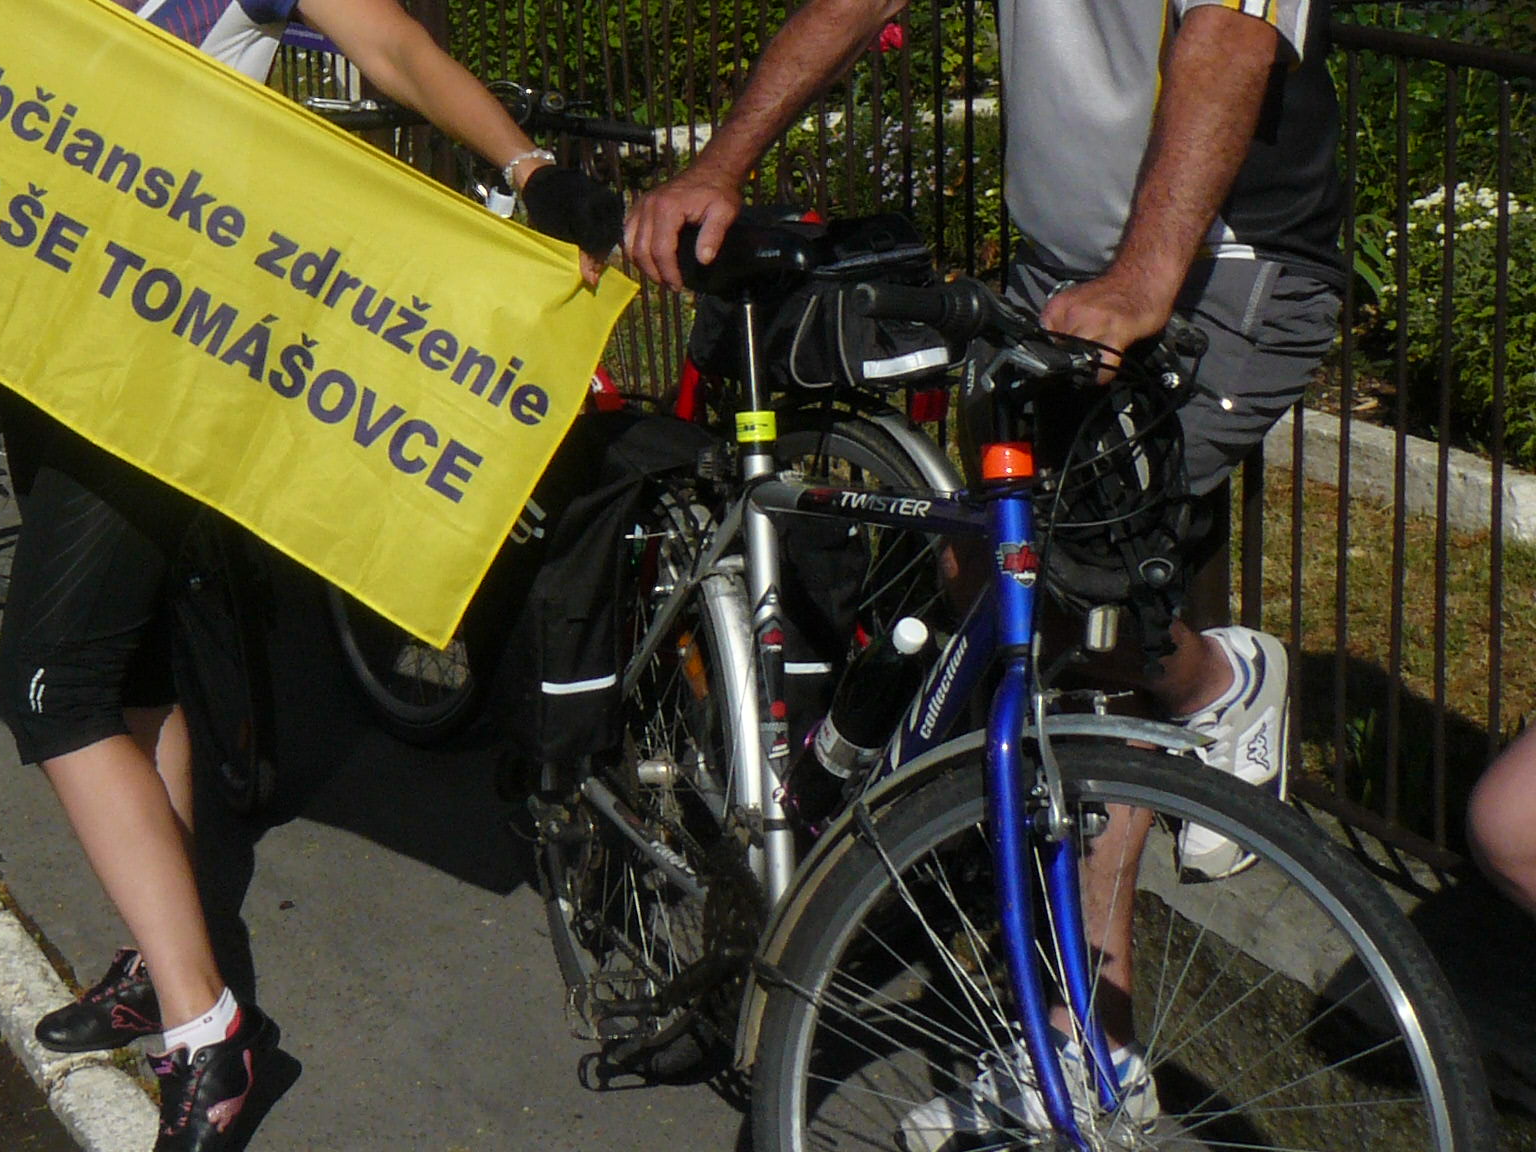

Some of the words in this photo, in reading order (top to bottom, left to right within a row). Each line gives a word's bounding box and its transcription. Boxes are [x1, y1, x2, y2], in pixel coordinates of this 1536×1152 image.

[97, 240, 484, 504] TOMÁŠOVCE
[253, 231, 550, 427] združenie
[840, 491, 932, 518] TWISTER
[919, 634, 969, 740] collection
